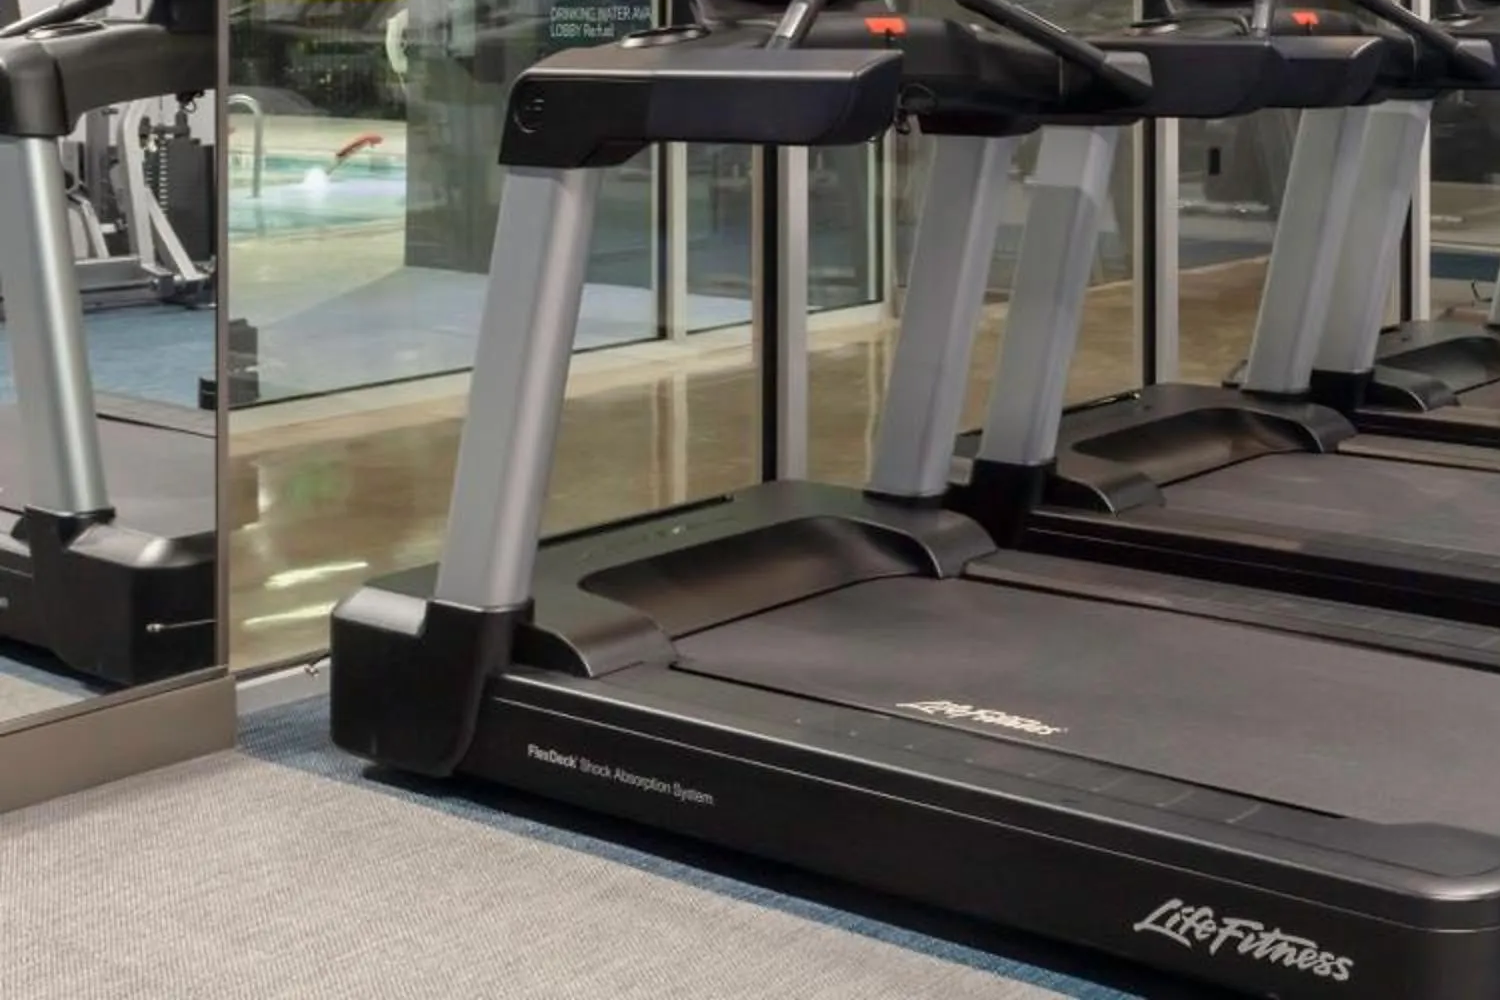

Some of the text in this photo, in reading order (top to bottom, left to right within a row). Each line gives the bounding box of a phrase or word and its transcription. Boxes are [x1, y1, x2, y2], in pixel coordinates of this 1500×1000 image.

[550, 5, 597, 22] DRINKING
[598, 4, 631, 21] WATER
[551, 22, 581, 38] LOBBY
[527, 743, 714, 805] FlexDeck Shock Absorption System
